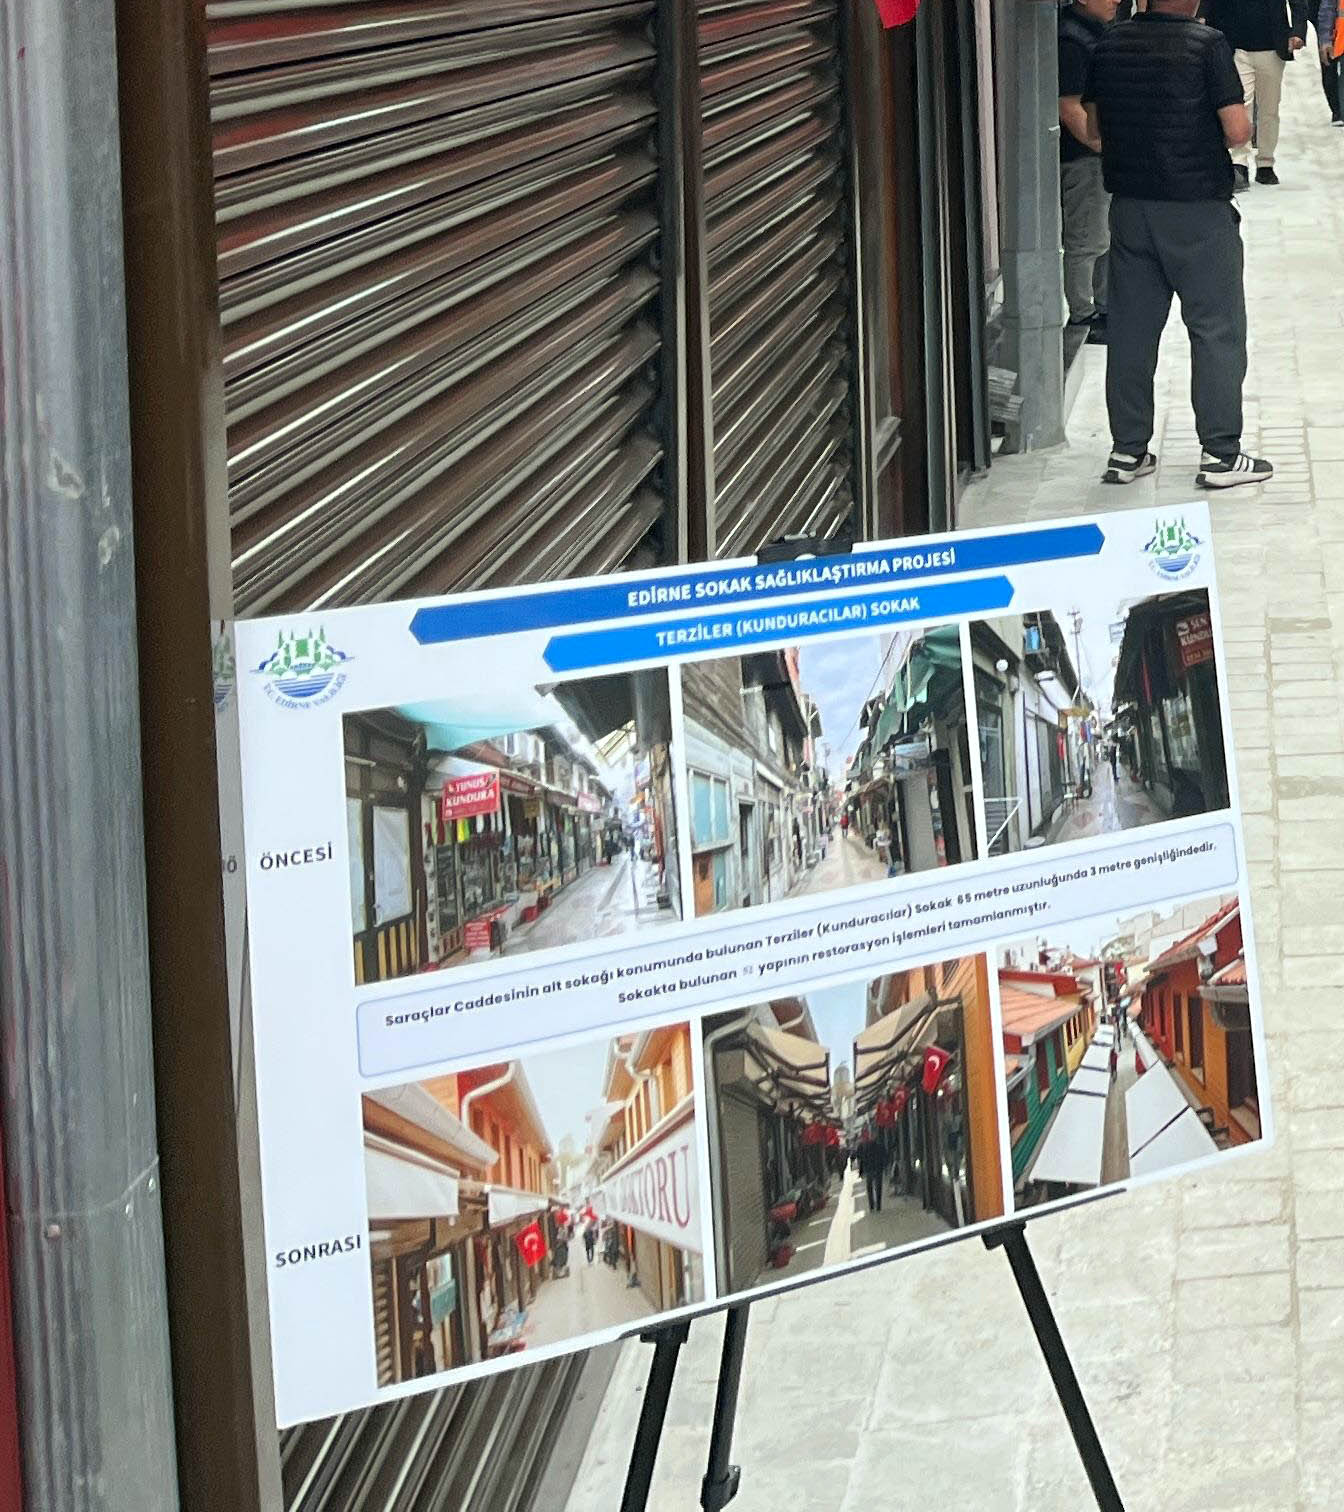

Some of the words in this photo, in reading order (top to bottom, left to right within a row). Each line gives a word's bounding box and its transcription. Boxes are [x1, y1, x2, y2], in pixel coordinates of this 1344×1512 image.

[628, 586, 691, 607] EDİRNE
[695, 576, 752, 599] SOKAK
[755, 560, 890, 592] SAĞLIKLAŞTIRMA
[892, 546, 956, 571] PROJESİ
[656, 619, 733, 646] TERZİLER
[736, 605, 867, 638] (KUNDURACILAR)
[870, 596, 920, 617] SOKAK
[260, 843, 333, 871] ÖNCESİ
[385, 1002, 452, 1027] Saraçlar
[542, 980, 562, 995] alt
[564, 971, 615, 991] sokağı
[616, 950, 703, 979] konumunda
[705, 938, 764, 960] bulunan
[766, 925, 816, 949] Terziler
[817, 901, 914, 938] (Kunduracılar)
[915, 896, 953, 914] Sokak
[957, 892, 973, 905] 65
[974, 885, 1010, 900] metre
[1011, 868, 1088, 895] uzunluğunda
[1098, 858, 1132, 875] metre
[1134, 841, 1217, 874] genişliğindedir.
[617, 977, 677, 1005] Sokakta
[679, 967, 738, 992] bulunan
[757, 952, 810, 977] yapının
[812, 933, 890, 965] restorasyon
[891, 921, 947, 948] işlemleri
[947, 899, 1051, 933] tamamlanmıştır.
[275, 1234, 362, 1268] SONRASI
